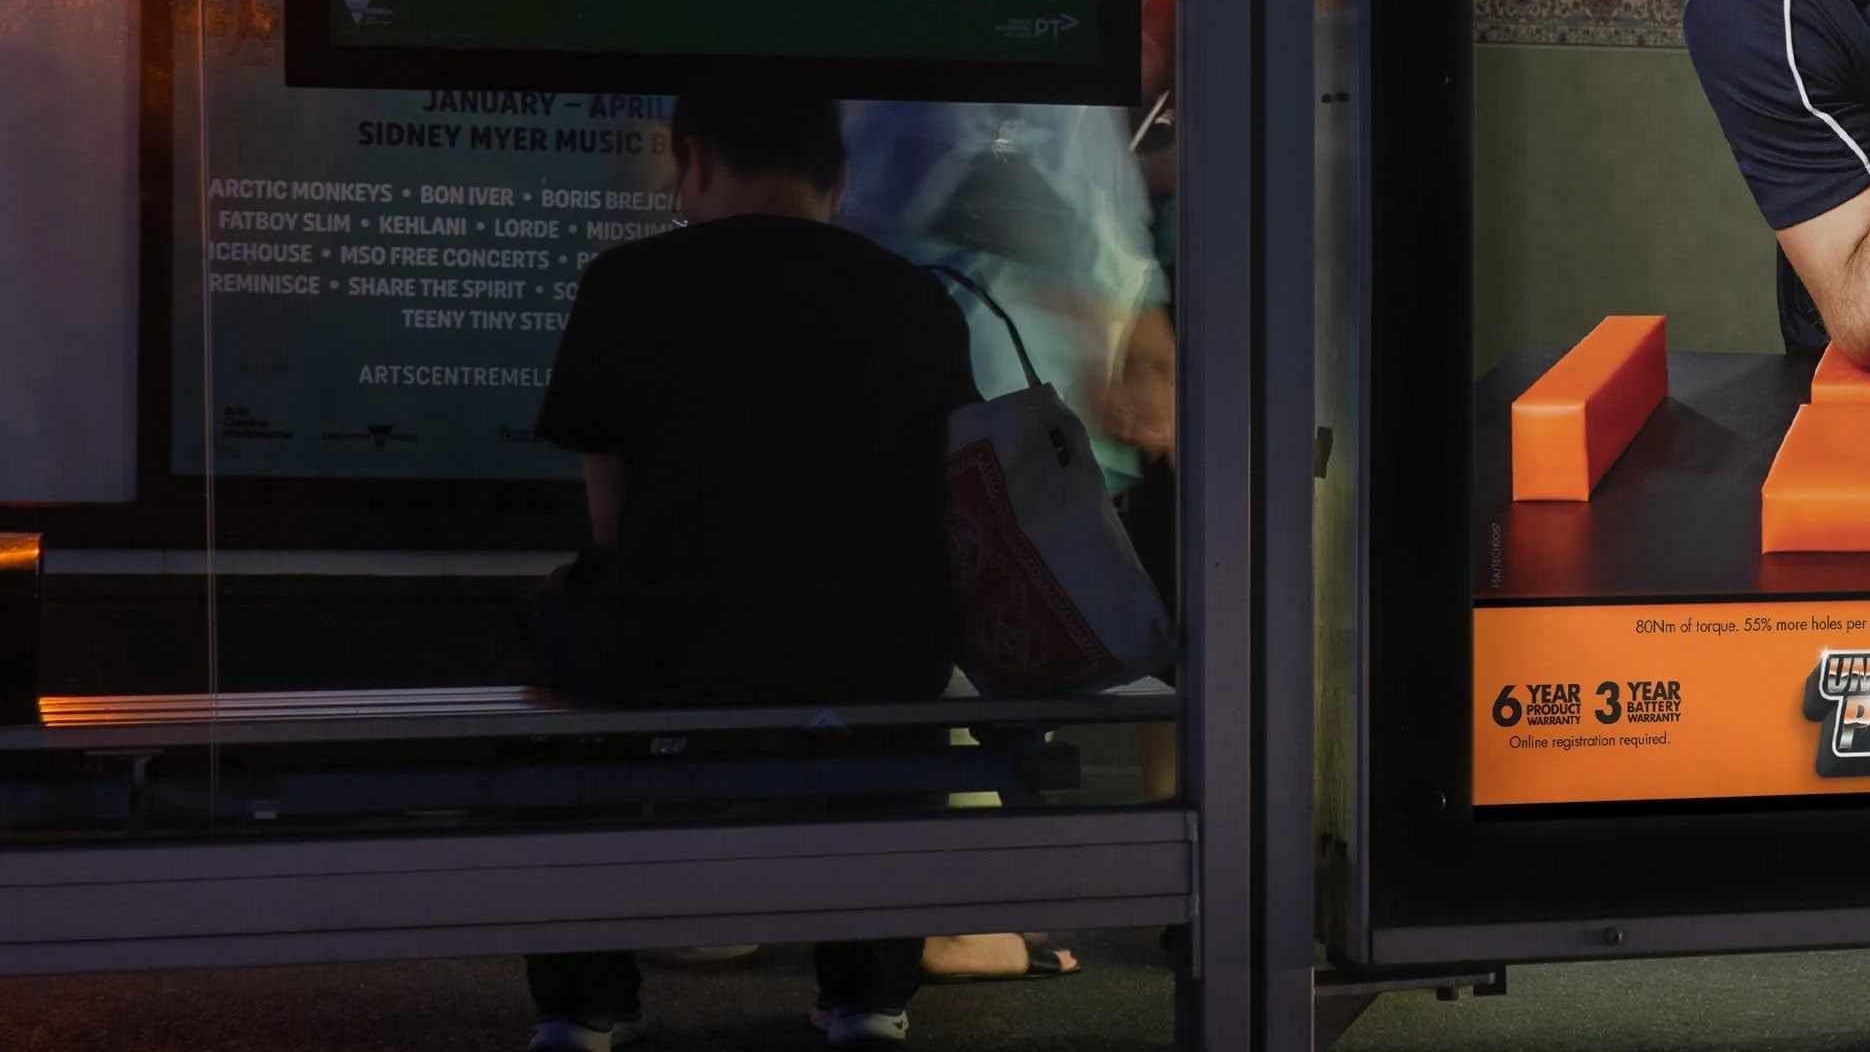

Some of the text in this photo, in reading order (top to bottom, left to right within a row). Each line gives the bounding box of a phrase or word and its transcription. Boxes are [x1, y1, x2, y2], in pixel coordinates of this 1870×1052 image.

[424, 89, 556, 115] JANUARY
[589, 94, 670, 121] APRIL
[359, 122, 461, 148] SIDNEY
[470, 126, 547, 151] MYER
[556, 129, 642, 155] MUSIC
[209, 179, 286, 199] ARCTIC
[293, 181, 392, 202] MONKEYS
[420, 185, 463, 204] BON
[469, 187, 513, 206] IVER
[542, 189, 600, 209] BORIS
[219, 210, 298, 231] FATBOY
[303, 213, 351, 233] SLIM
[380, 215, 466, 236] KEHLANI
[495, 218, 559, 238] LORDE
[208, 242, 549, 269] ICEHOUSE MSO FREE CONCERTS
[208, 273, 526, 299] REMINISCE SHARE THE SPIRIT
[402, 309, 465, 329] TEENY
[469, 310, 516, 330] TINY
[1636, 619, 1676, 634] 80Nm
[1680, 618, 1693, 633] of
[1697, 617, 1740, 636] torque.
[1744, 617, 1772, 632] 55%
[1776, 619, 1807, 631] more
[1811, 615, 1842, 631] holes
[1847, 618, 1867, 634] per
[1492, 683, 1581, 727] 6 YEAR
[1527, 703, 1581, 715] PRODUCT
[1595, 681, 1681, 725] 3 YEAR
[1627, 701, 1681, 713] BATTERY
[1527, 715, 1581, 726] WARRANTY
[1628, 712, 1681, 723] WARRANTY
[1509, 731, 1671, 751] Online registration required.
